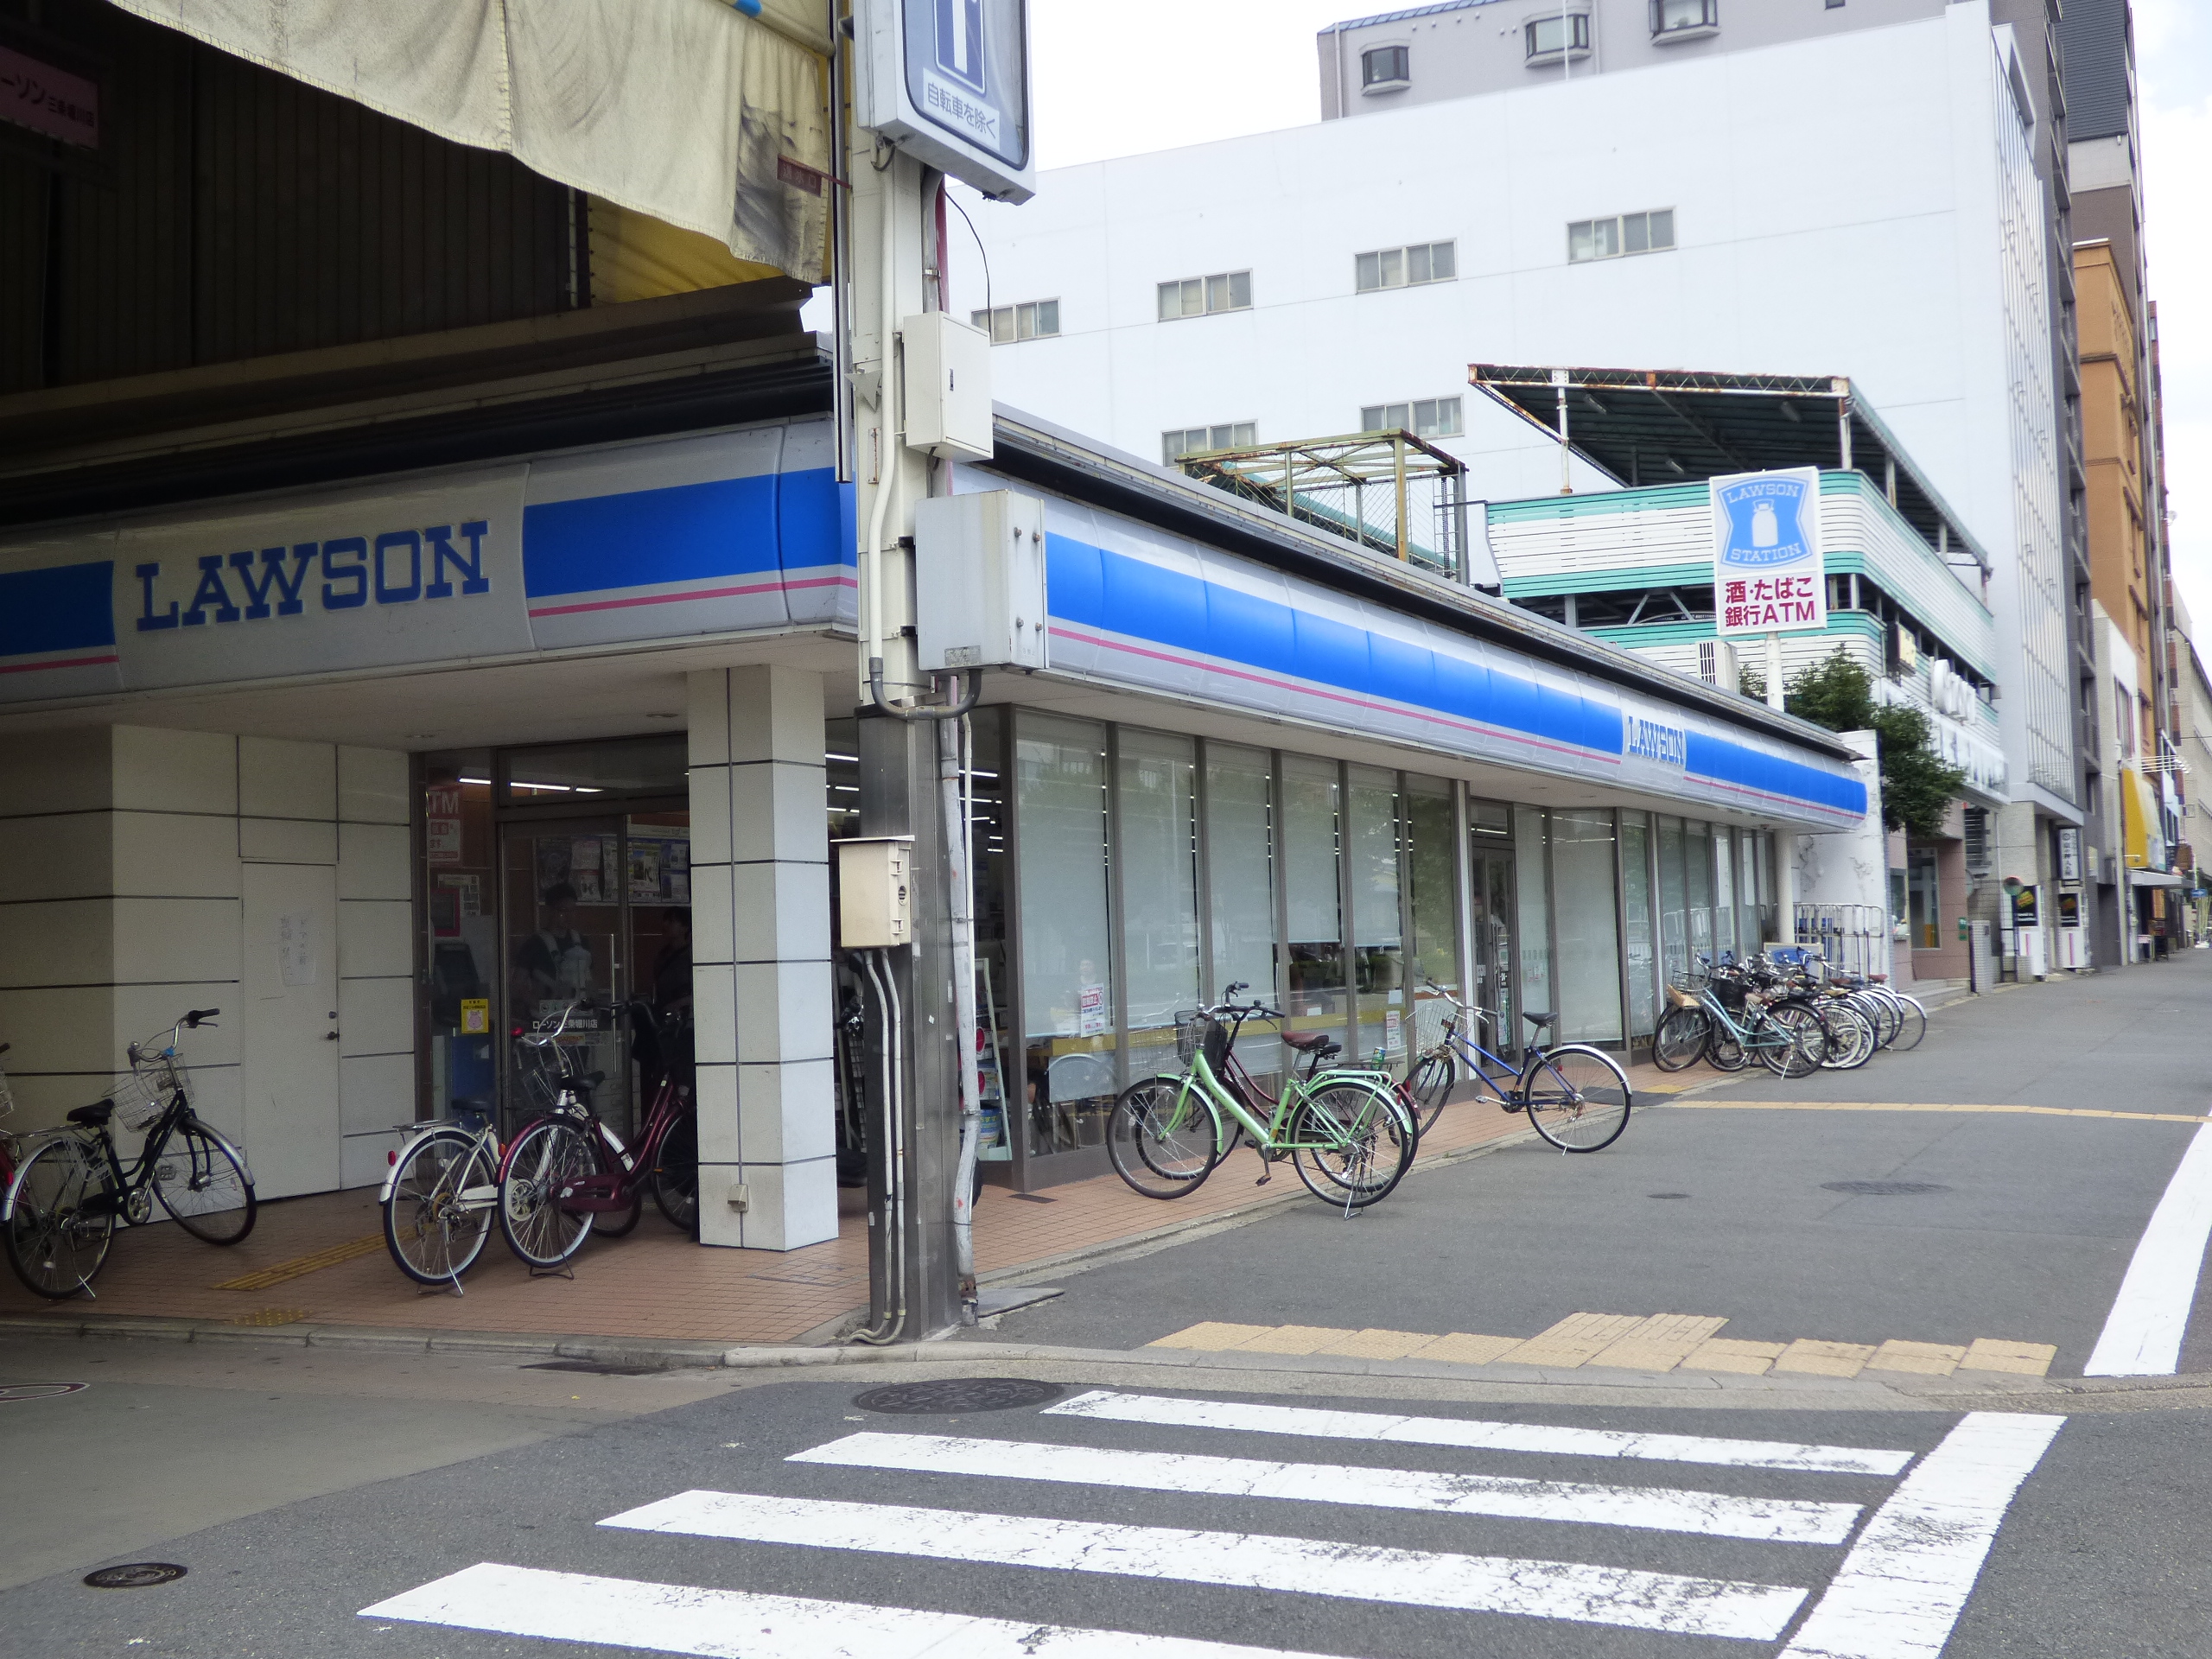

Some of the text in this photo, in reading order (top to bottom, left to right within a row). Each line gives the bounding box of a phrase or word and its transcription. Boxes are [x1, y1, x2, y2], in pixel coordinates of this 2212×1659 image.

[927, 82, 996, 139] 自転車を除く
[1726, 483, 1801, 504] LAWSON
[1731, 543, 1802, 562] STATION
[135, 519, 490, 632] LAWSON
[1725, 601, 1815, 627] 銀行ATM
[1628, 715, 1684, 765] LAWSON
[428, 791, 459, 814] TM
